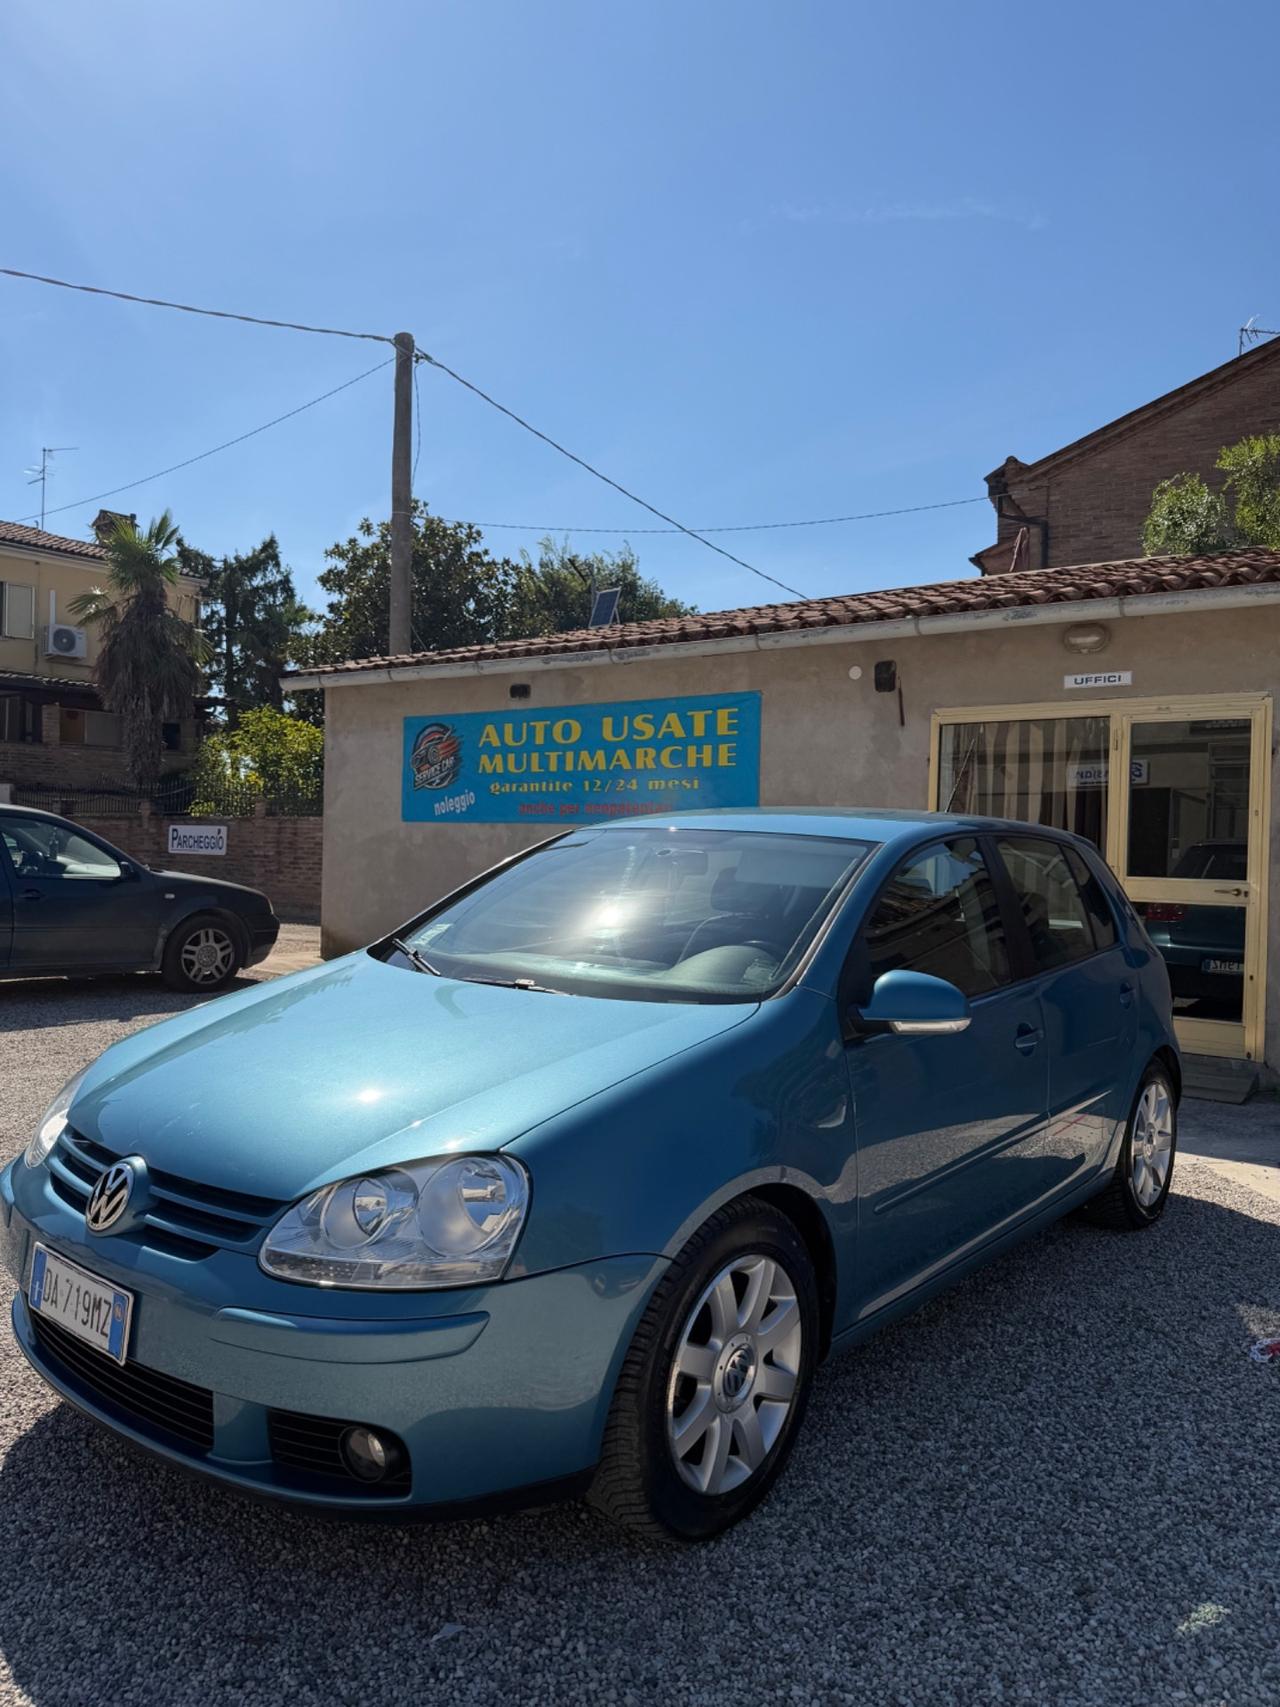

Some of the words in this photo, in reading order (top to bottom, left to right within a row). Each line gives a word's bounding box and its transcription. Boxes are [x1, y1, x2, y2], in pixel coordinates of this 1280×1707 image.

[1073, 674, 1122, 685] UFFICI
[478, 719, 582, 748] AUTO
[602, 708, 739, 742] USATE
[478, 743, 738, 775] MULTIMARCHE
[490, 780, 573, 794] garantite
[583, 778, 639, 792] 12/24
[648, 777, 700, 790] mesi
[434, 789, 476, 816] noleggio
[43, 1268, 59, 1309] DA
[63, 1278, 112, 1338] 719MZ
